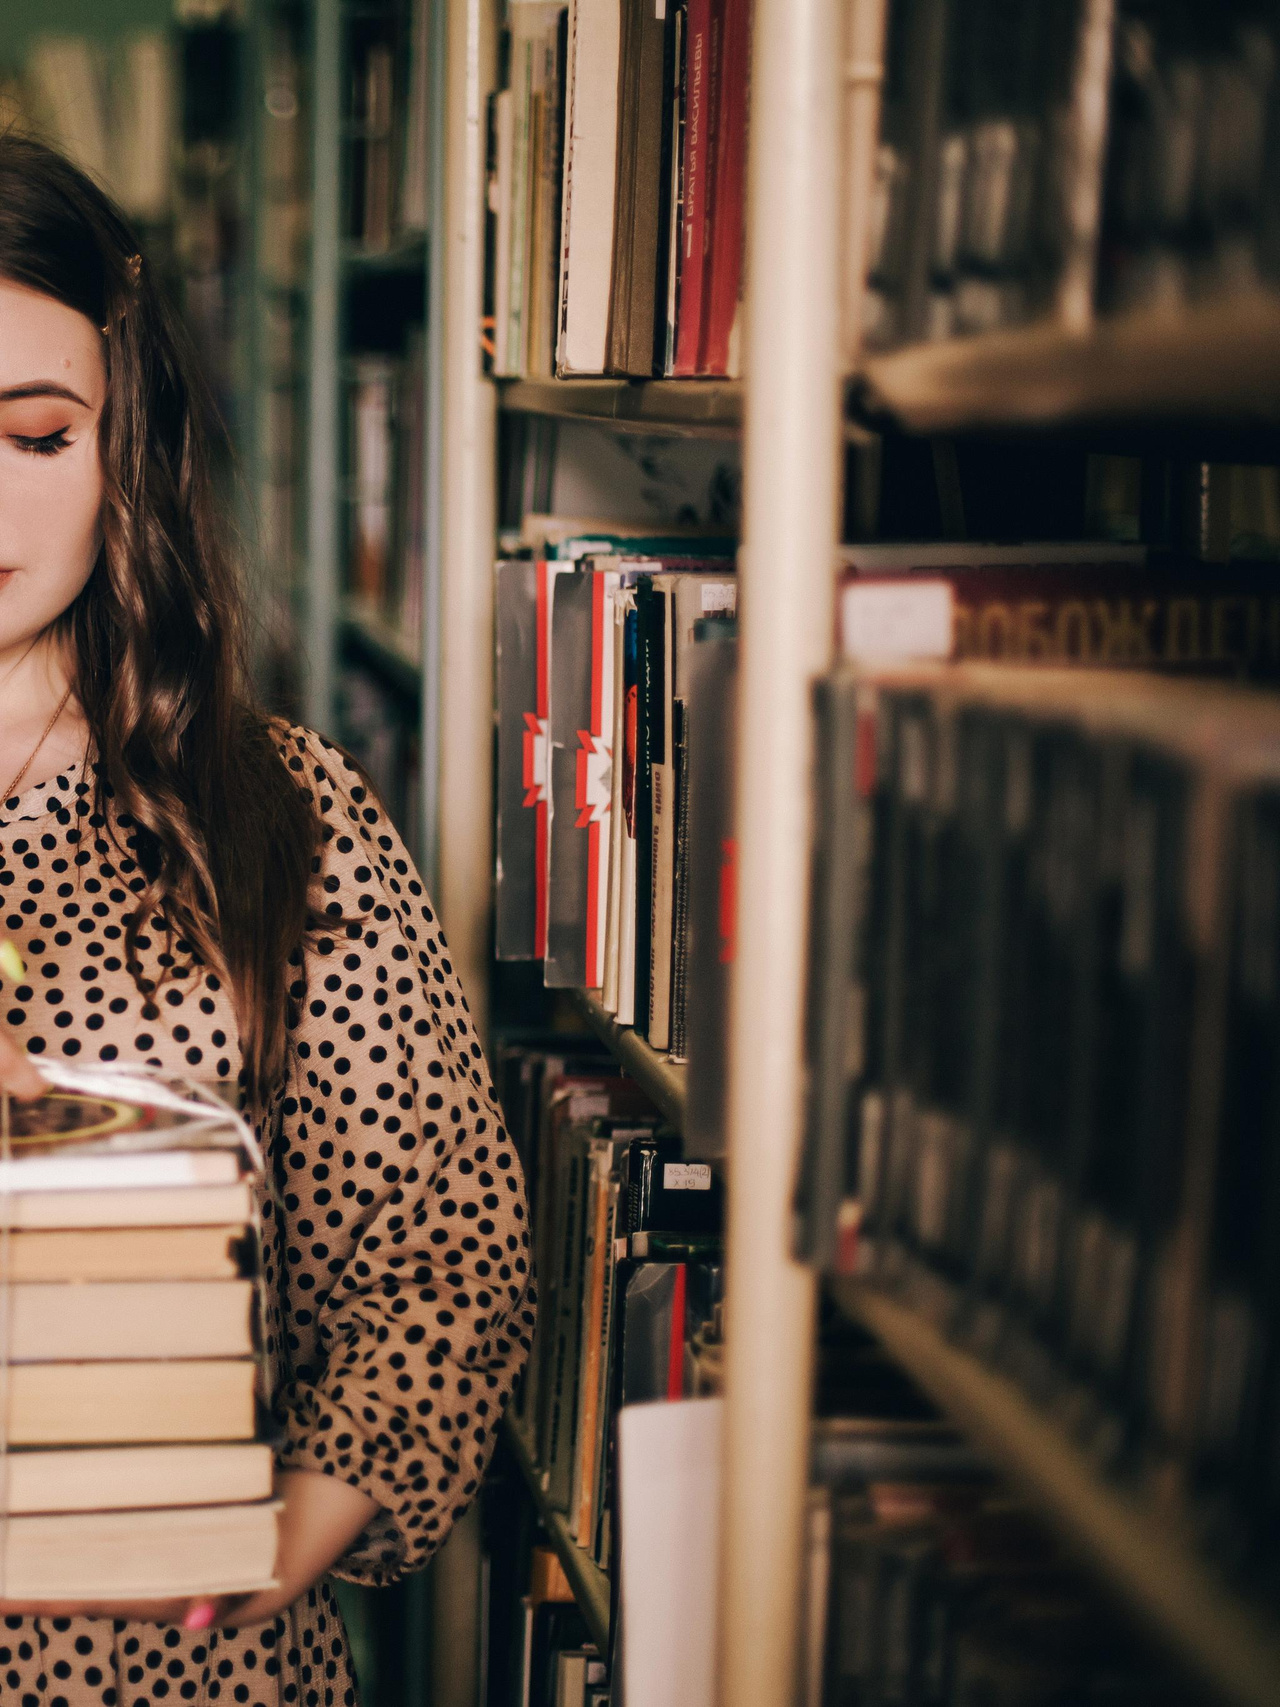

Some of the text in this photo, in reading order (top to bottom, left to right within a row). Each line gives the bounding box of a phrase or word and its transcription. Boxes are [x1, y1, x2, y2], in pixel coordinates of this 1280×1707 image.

[691, 33, 703, 146] ВАСИЛЬЕВЫ
[687, 150, 697, 217] БРАТЬЯ
[654, 771, 662, 815] КИНО
